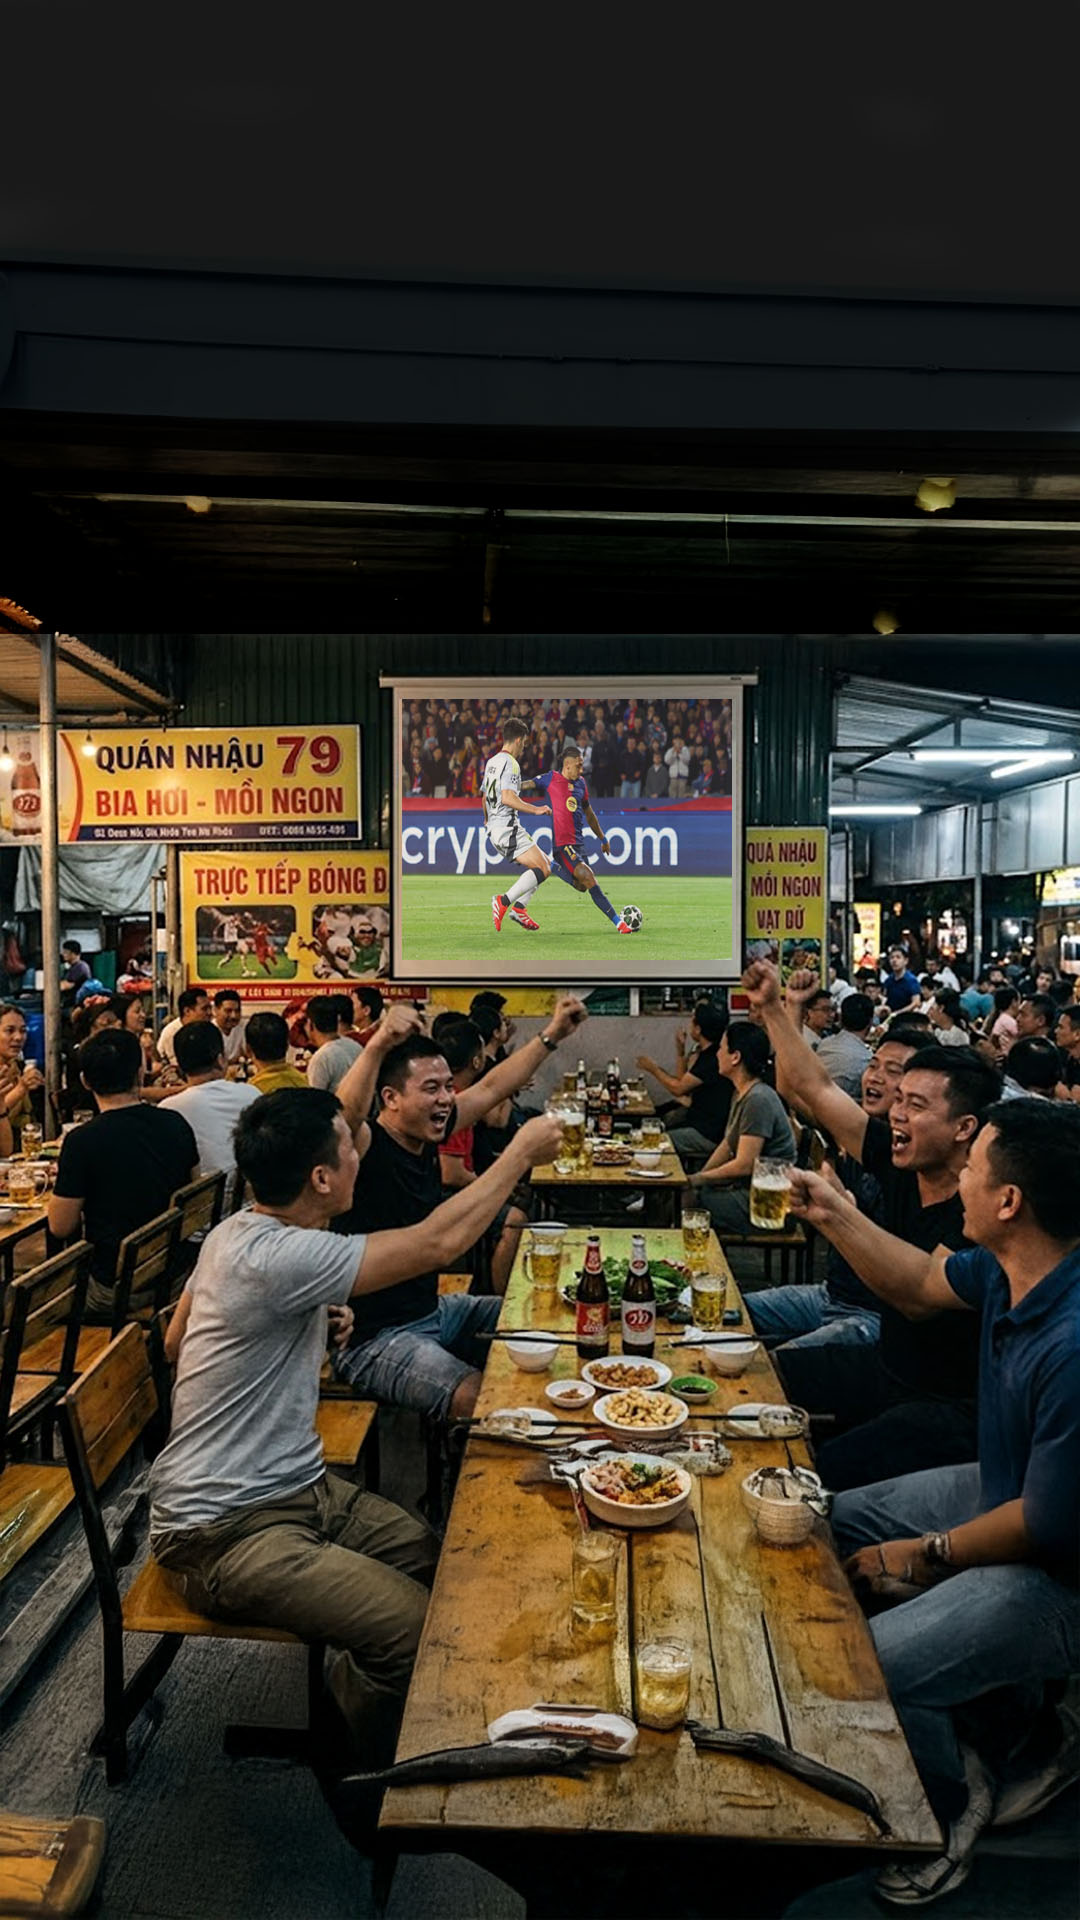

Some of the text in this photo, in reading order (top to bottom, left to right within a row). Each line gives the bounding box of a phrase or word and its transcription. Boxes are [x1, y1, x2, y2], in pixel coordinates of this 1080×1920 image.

[96, 735, 343, 777] QUÁN NHẬU 79
[96, 790, 138, 817] BIA
[272, 786, 344, 814] NGON
[194, 866, 249, 901] TRỰC
[256, 859, 302, 895] TIẾP
[308, 861, 367, 895] BÓNG
[782, 876, 821, 897] NGON
